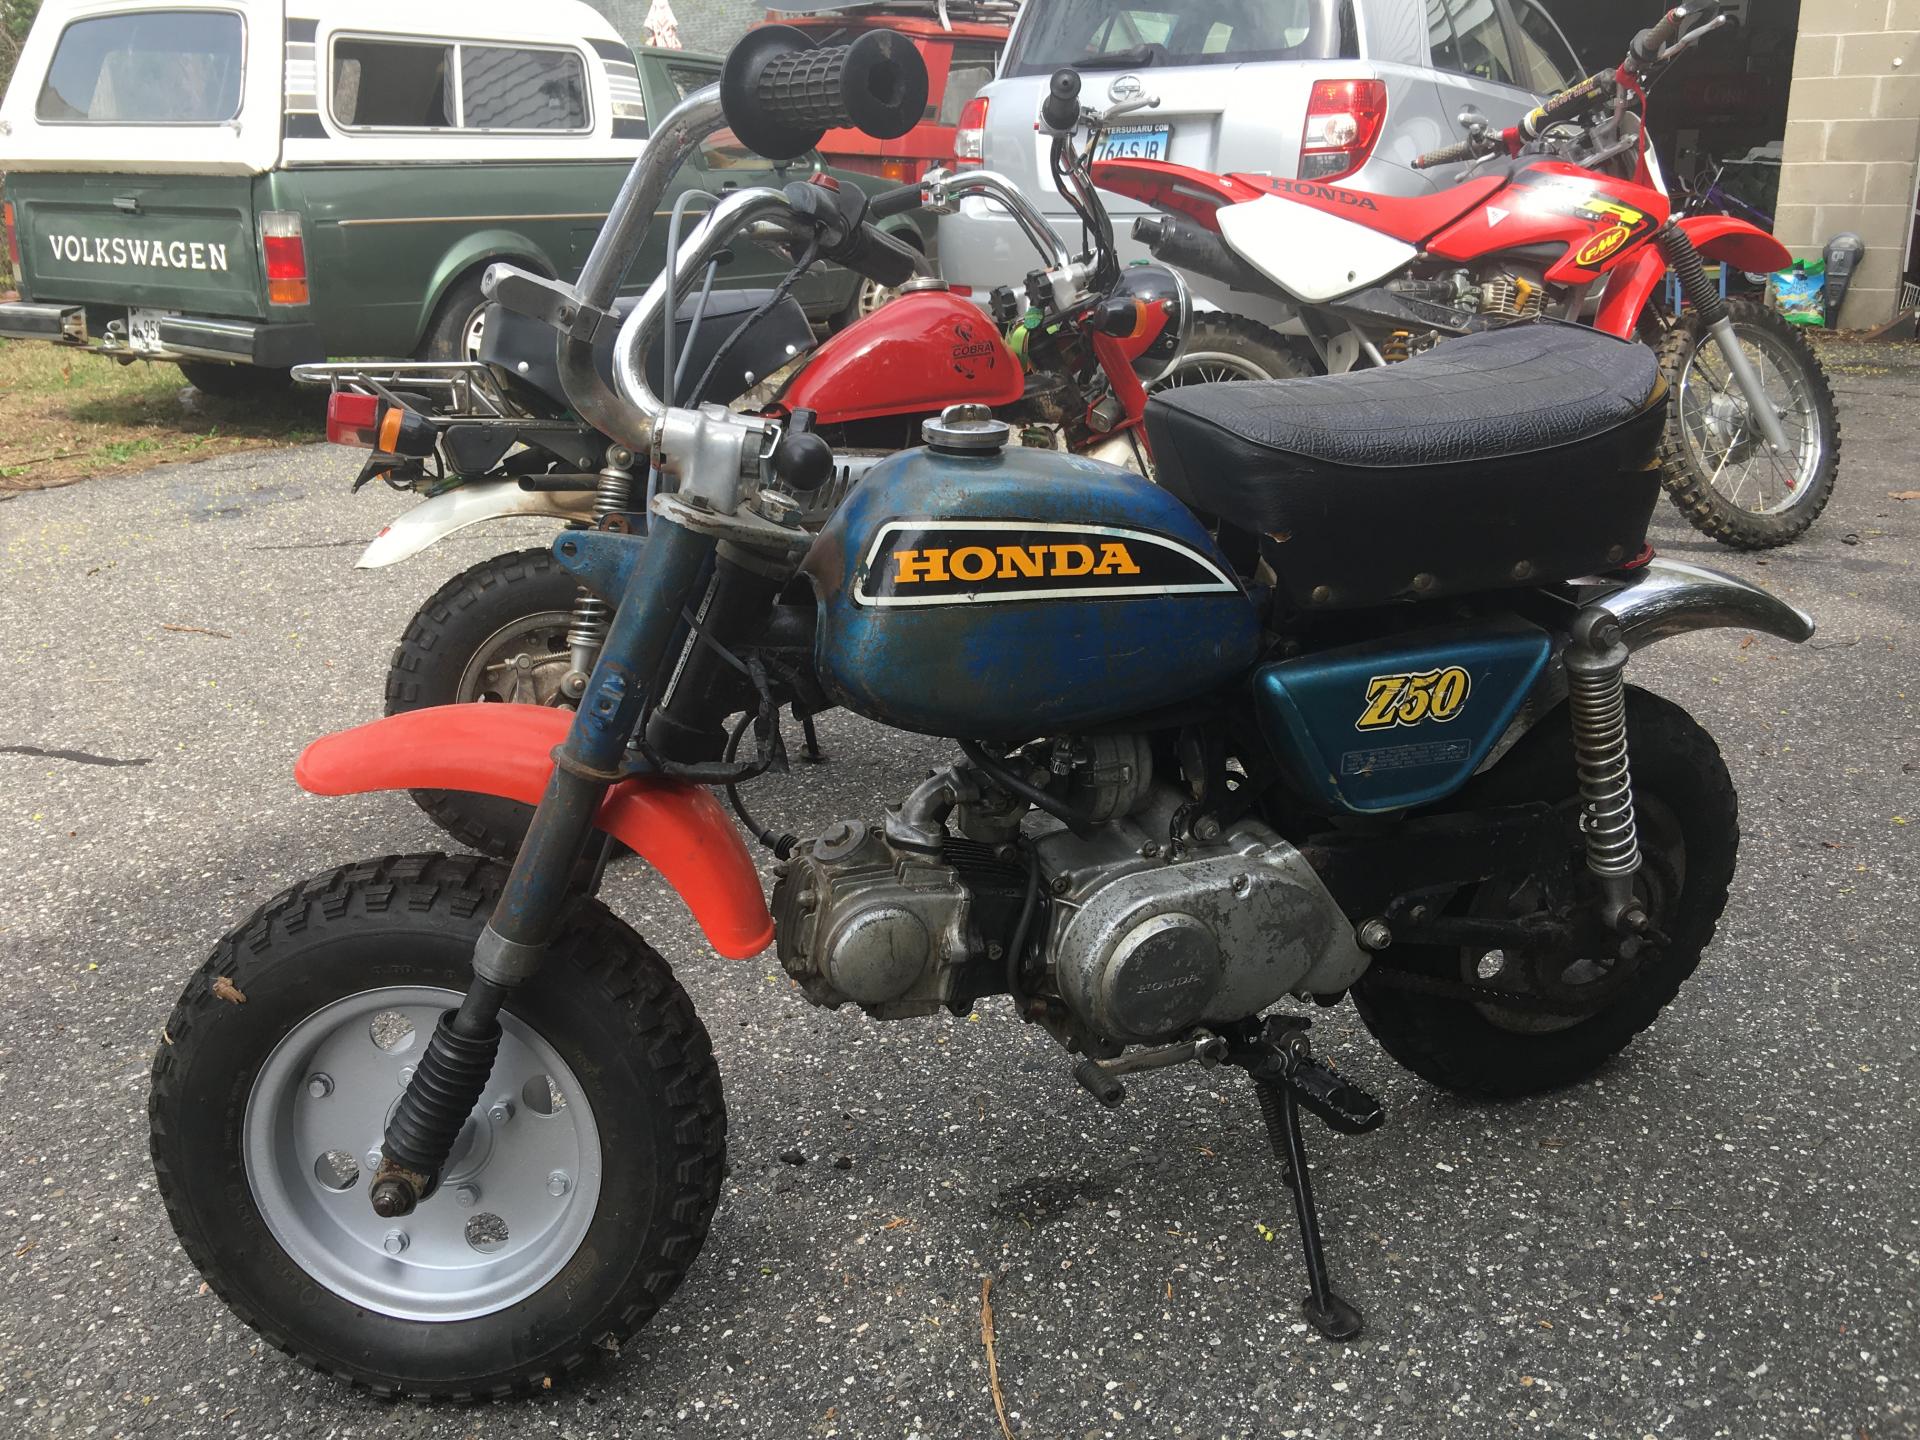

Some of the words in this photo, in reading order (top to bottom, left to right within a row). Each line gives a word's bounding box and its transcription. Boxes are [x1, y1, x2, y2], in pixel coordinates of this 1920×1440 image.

[1271, 178, 1379, 211] HONDA
[49, 235, 227, 271] VOLKSWAGEN
[1585, 229, 1623, 262] FMF
[953, 341, 995, 357] COBRA
[893, 543, 1141, 584] HONDA
[1355, 665, 1472, 732] Z50
